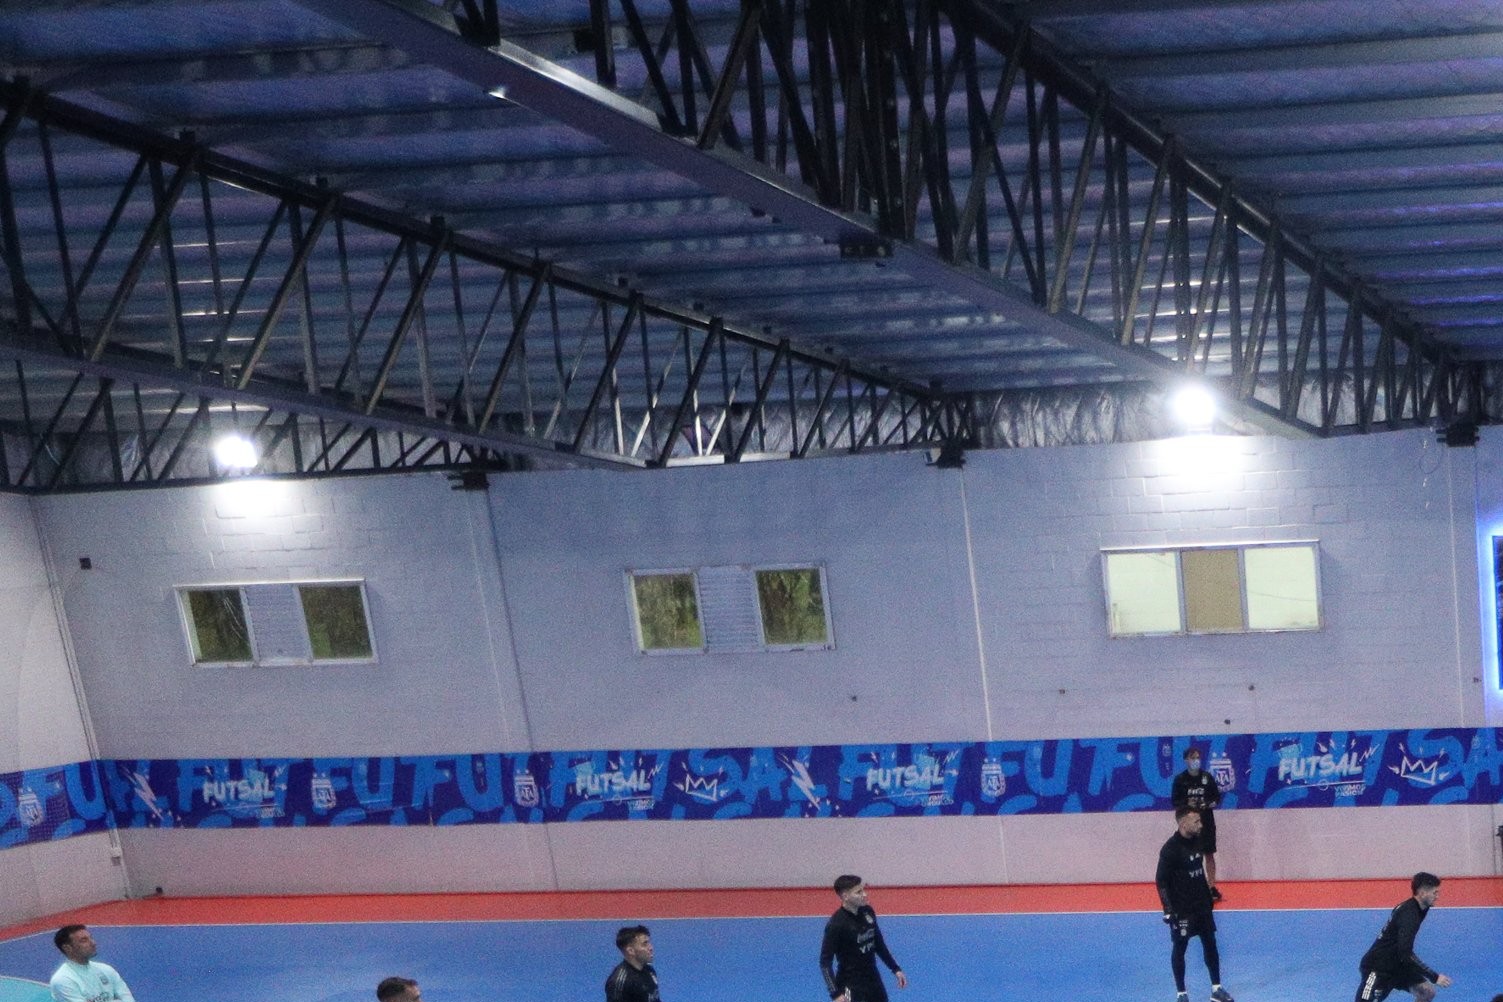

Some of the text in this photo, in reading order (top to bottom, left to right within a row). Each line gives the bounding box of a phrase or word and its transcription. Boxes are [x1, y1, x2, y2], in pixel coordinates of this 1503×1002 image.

[866, 763, 945, 792] FUTSAL
[1278, 751, 1363, 781] FUTSAL
[203, 775, 275, 804] FUTSAL
[576, 768, 652, 797] FUTSAL
